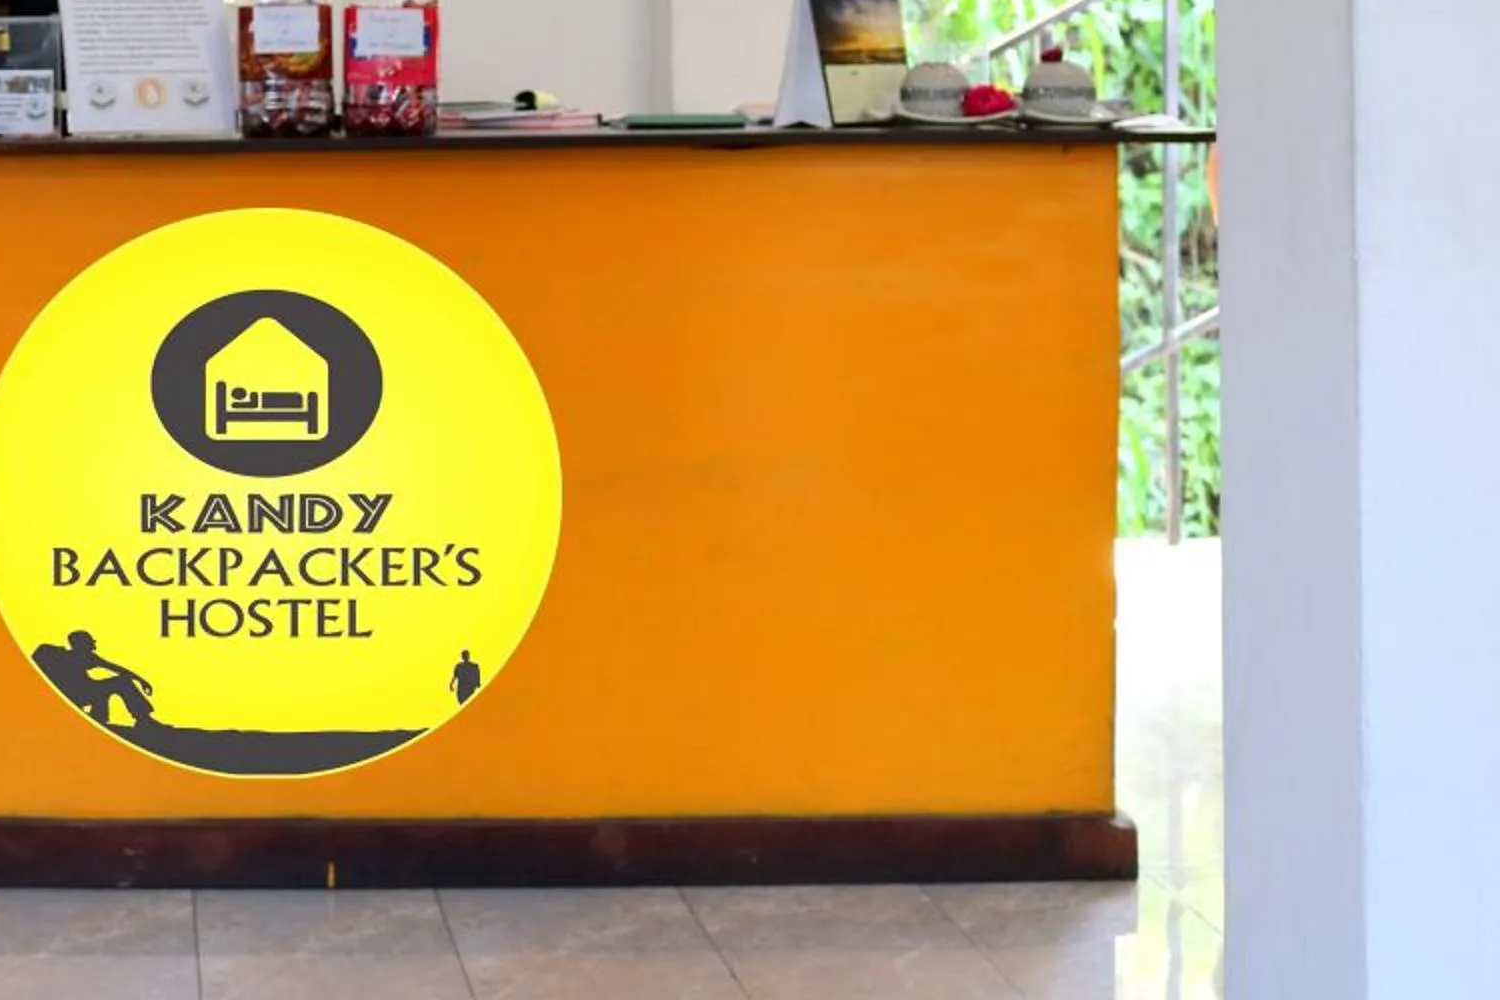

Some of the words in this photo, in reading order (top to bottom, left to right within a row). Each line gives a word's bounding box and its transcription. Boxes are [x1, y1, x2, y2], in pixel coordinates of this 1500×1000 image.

[140, 493, 393, 534] KANDY
[52, 543, 482, 587] BACKPACKER'S
[160, 599, 373, 638] HOSTEL
